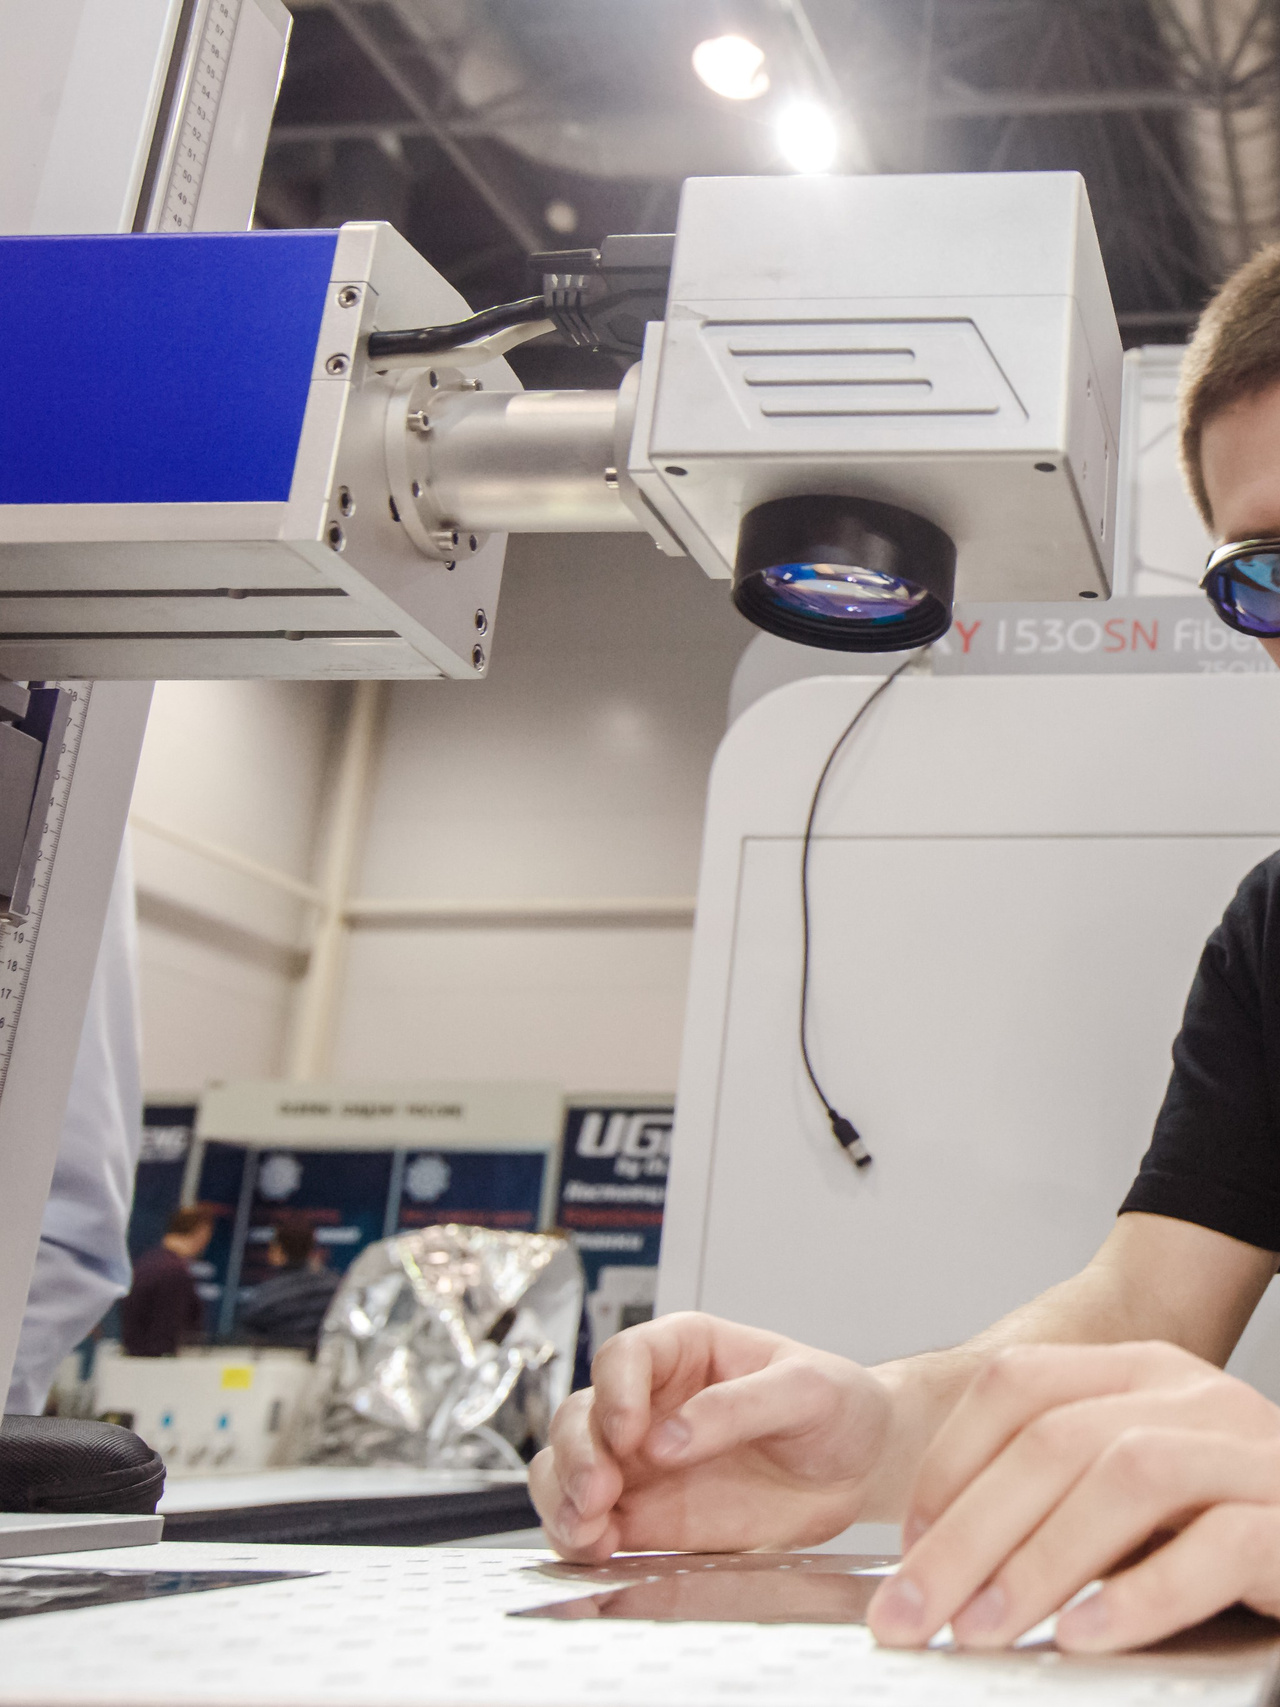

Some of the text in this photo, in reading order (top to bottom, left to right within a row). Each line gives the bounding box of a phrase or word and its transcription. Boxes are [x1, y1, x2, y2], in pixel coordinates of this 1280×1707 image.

[183, 169, 192, 184] 50
[178, 192, 187, 205] 49
[13, 931, 24, 944] 19
[7, 959, 18, 972] 18
[0, 987, 12, 1000] 17
[576, 1112, 673, 1158] UG
